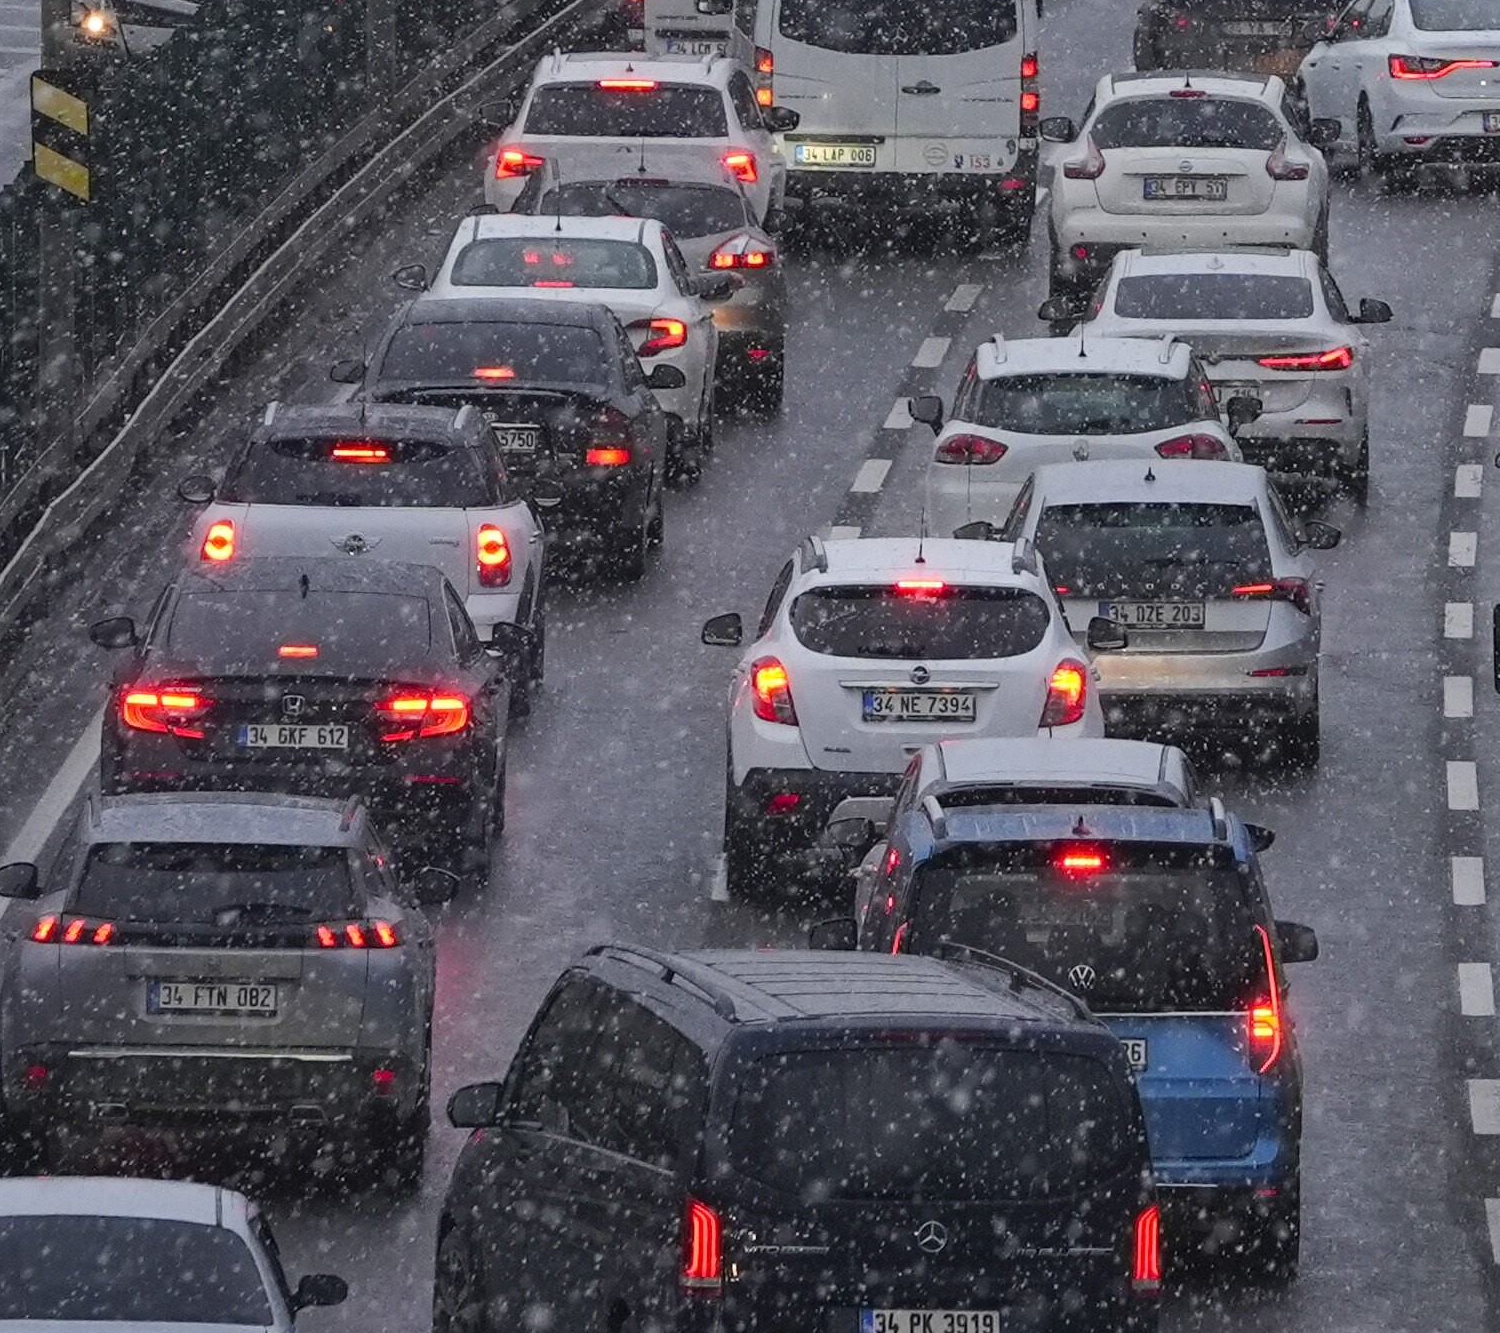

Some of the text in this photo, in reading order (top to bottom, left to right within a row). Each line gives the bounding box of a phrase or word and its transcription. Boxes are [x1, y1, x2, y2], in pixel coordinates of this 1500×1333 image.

[804, 149, 871, 161] 34 LAP 006
[1151, 180, 1165, 193] 34
[1108, 605, 1129, 622] 34
[873, 696, 971, 713] 34 NE 7394
[250, 727, 268, 745] 34
[318, 727, 345, 746] 612
[161, 986, 271, 1008] 34 FTN 082
[874, 1312, 994, 1333] 34 PK 3919
